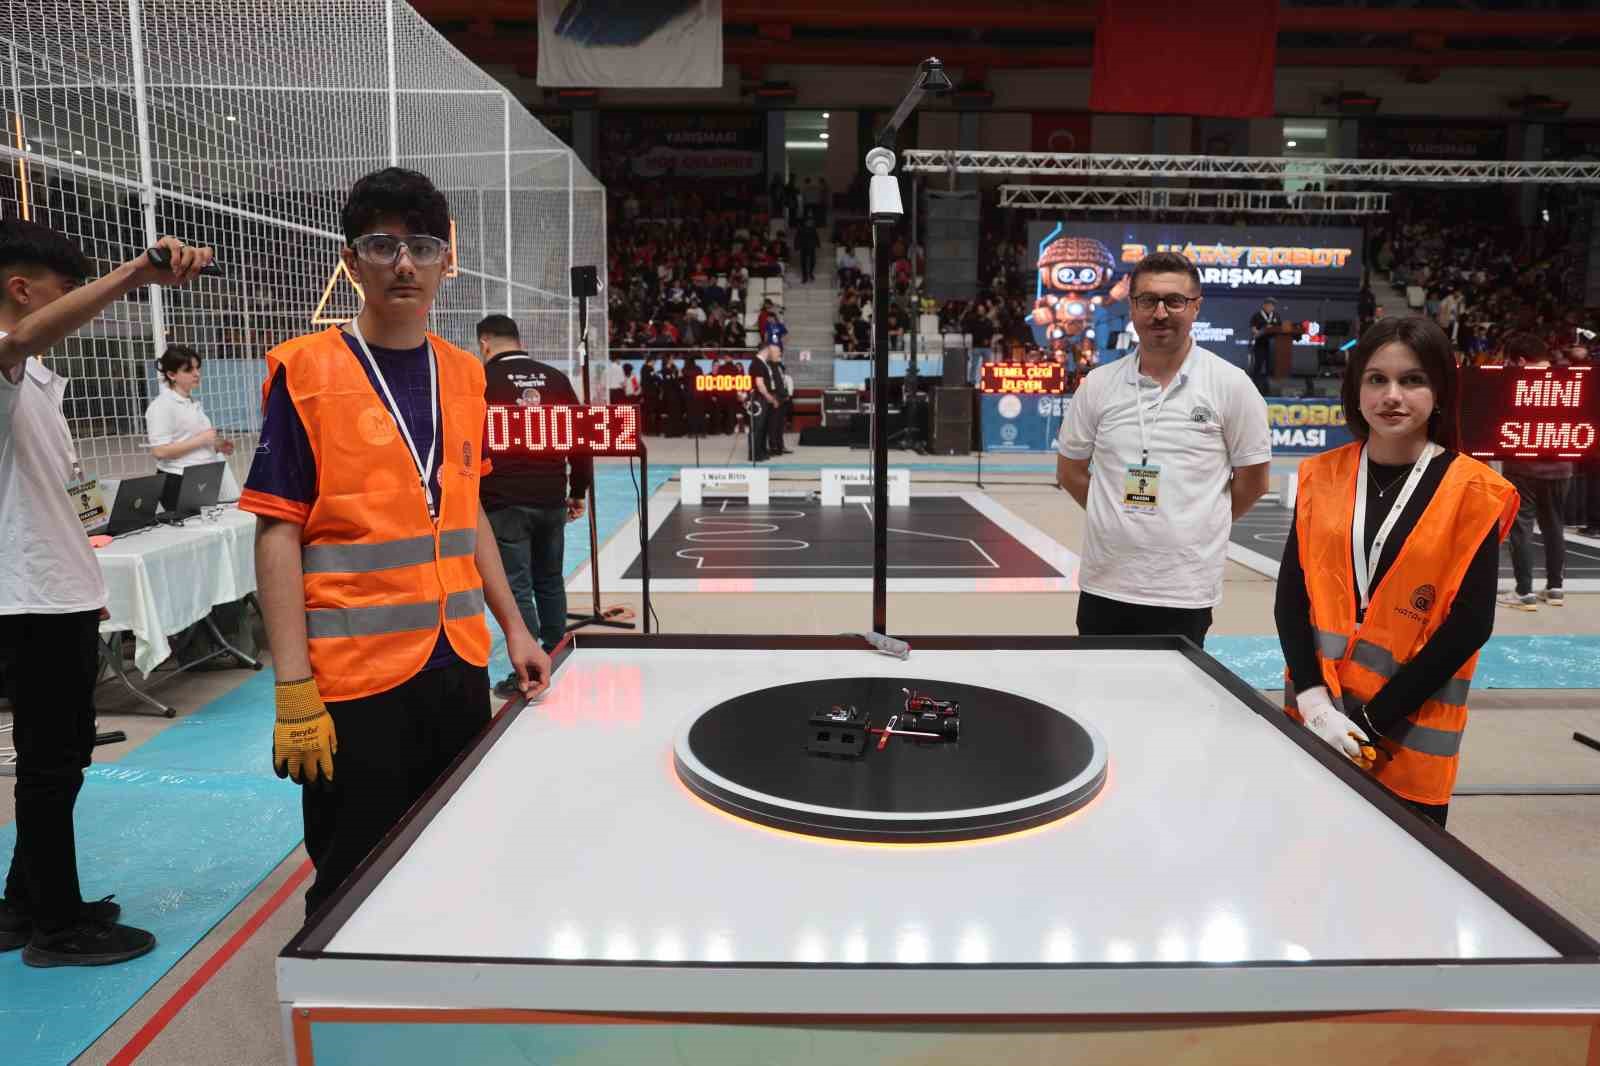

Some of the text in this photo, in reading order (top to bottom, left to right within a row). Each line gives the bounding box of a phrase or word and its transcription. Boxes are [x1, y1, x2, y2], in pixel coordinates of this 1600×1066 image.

[1247, 245, 1352, 268] ROBOT
[696, 375, 752, 391] 00:00:00
[1500, 421, 1595, 449] SUMO
